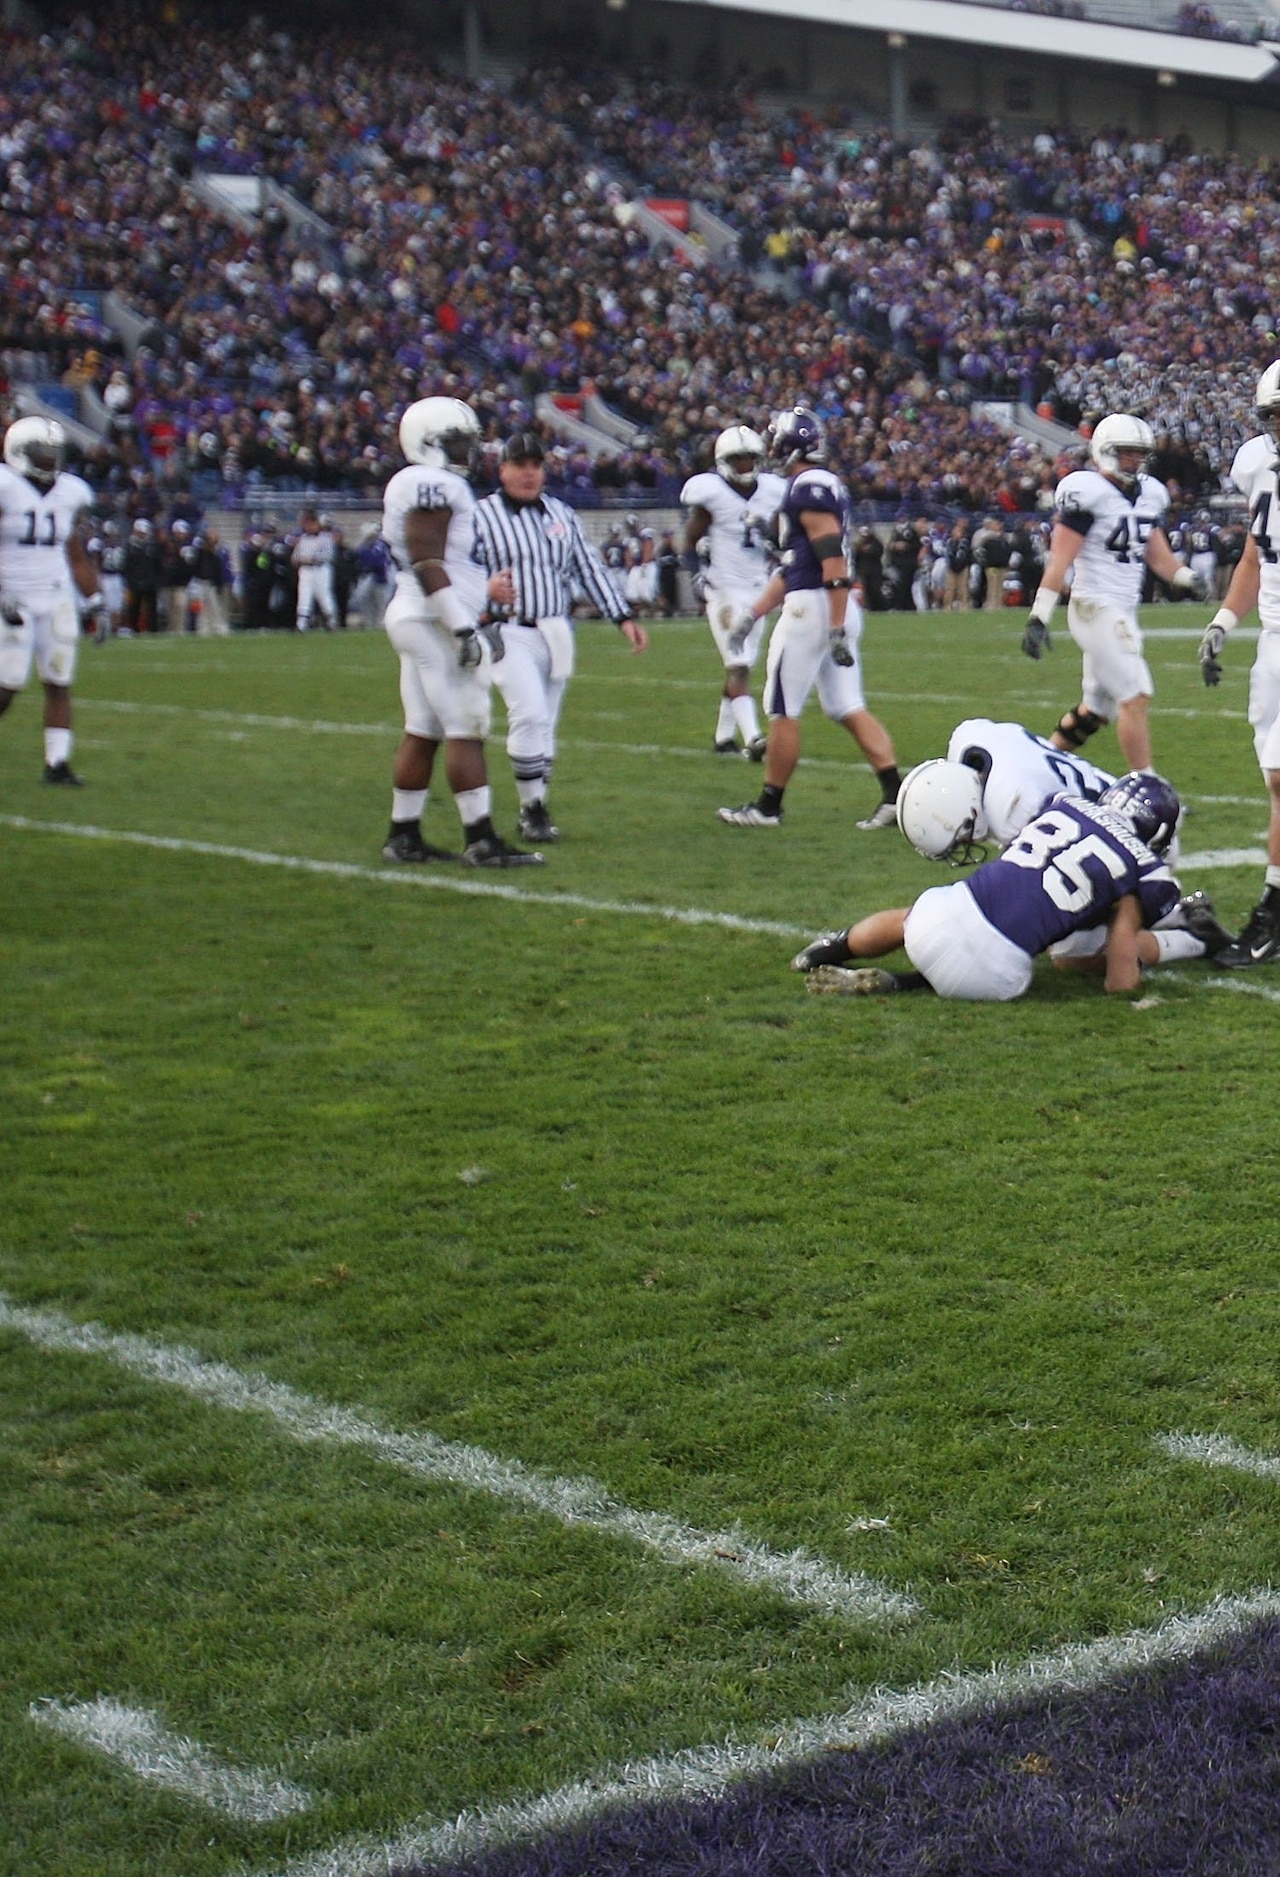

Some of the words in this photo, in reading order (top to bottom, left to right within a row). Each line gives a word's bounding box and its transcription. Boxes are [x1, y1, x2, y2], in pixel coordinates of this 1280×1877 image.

[417, 483, 448, 508] 85
[18, 510, 56, 545] 11
[1111, 790, 1140, 817] 85
[1001, 810, 1128, 913] 85
